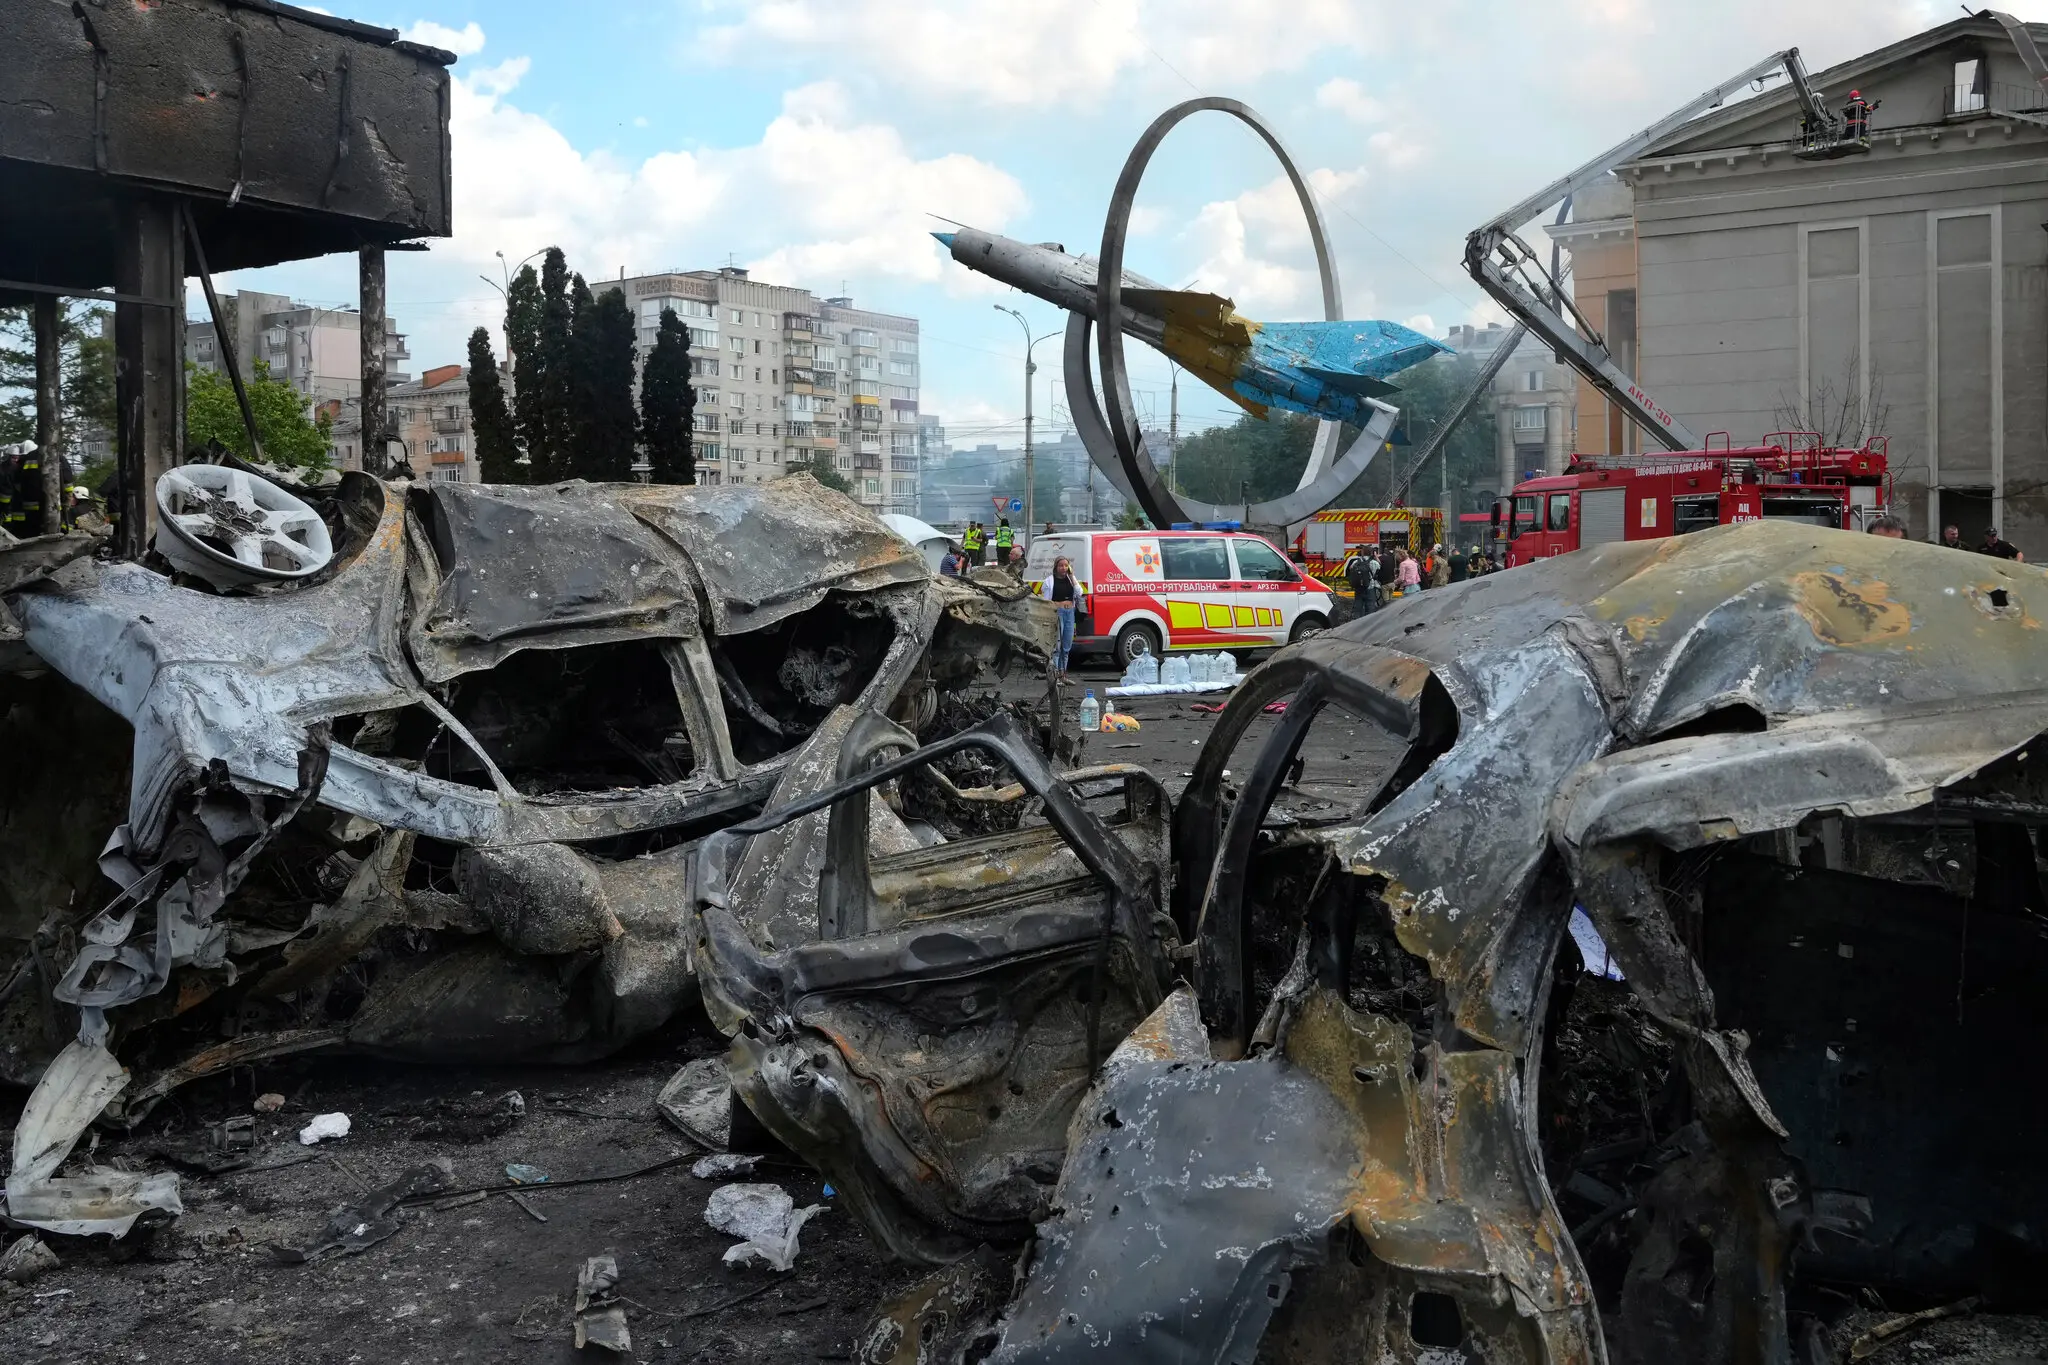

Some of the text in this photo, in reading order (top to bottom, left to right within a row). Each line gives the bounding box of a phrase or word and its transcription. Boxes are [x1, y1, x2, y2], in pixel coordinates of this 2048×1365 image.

[1628, 385, 1672, 427] АКП-30
[1738, 503, 1749, 514] АЦ
[1844, 505, 1849, 513] 2
